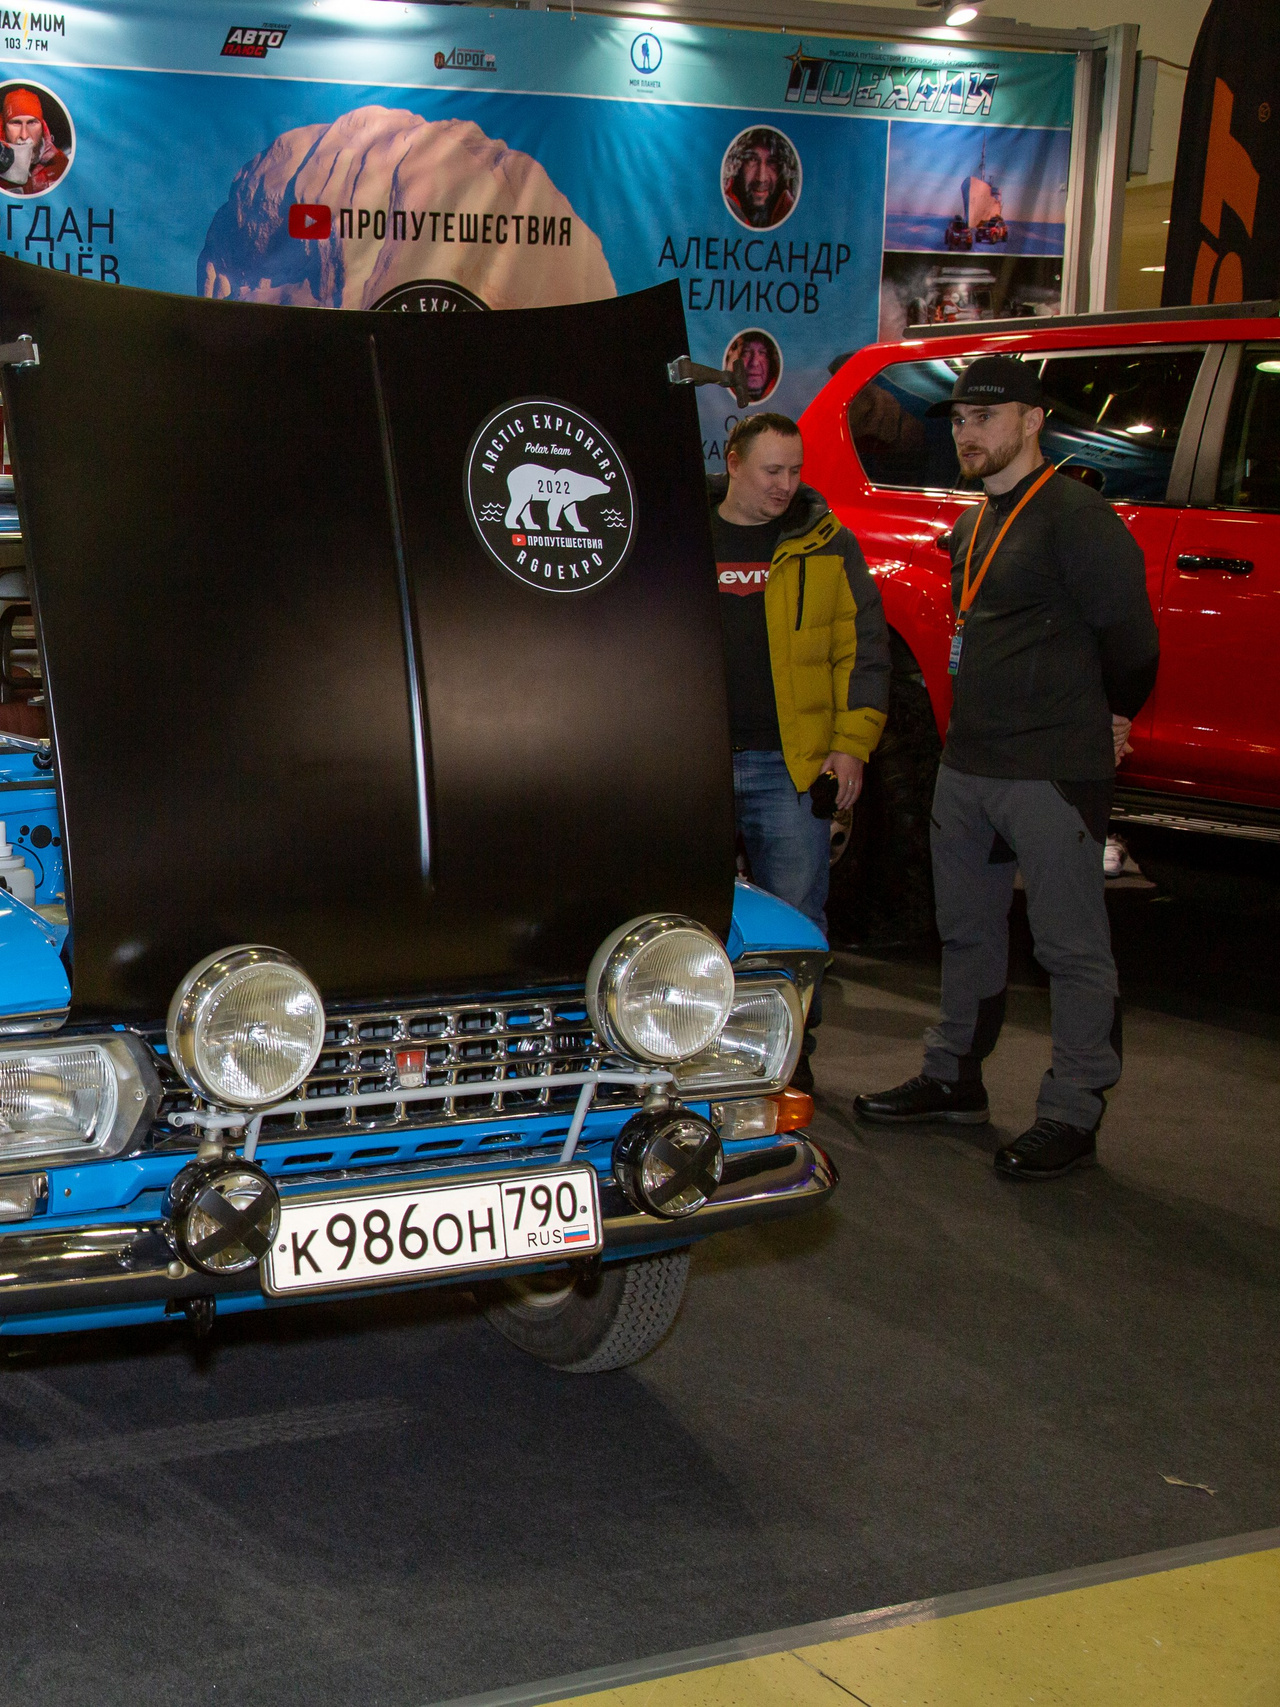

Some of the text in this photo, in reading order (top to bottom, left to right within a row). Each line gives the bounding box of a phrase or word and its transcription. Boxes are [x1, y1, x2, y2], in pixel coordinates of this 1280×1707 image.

[35, 39, 49, 51] FM
[228, 28, 284, 47] АВТО
[224, 43, 265, 56] ПЛЮС
[785, 59, 999, 116] ПОЕХАЛИ
[339, 207, 572, 246] ПРОПУТЕШЕСТВИЯ
[658, 235, 851, 283] АЛЕКСАНДР
[481, 414, 616, 481] ARCTIC EXPLORERS
[524, 442, 572, 456] Polar Team
[537, 479, 571, 494] 2022
[527, 535, 603, 550] ПРОПУТЕШЕСТВИЯ
[516, 549, 603, 580] RGOEXPO
[718, 569, 770, 584] evi'
[505, 1181, 578, 1231] 790
[527, 1229, 562, 1248] RUS
